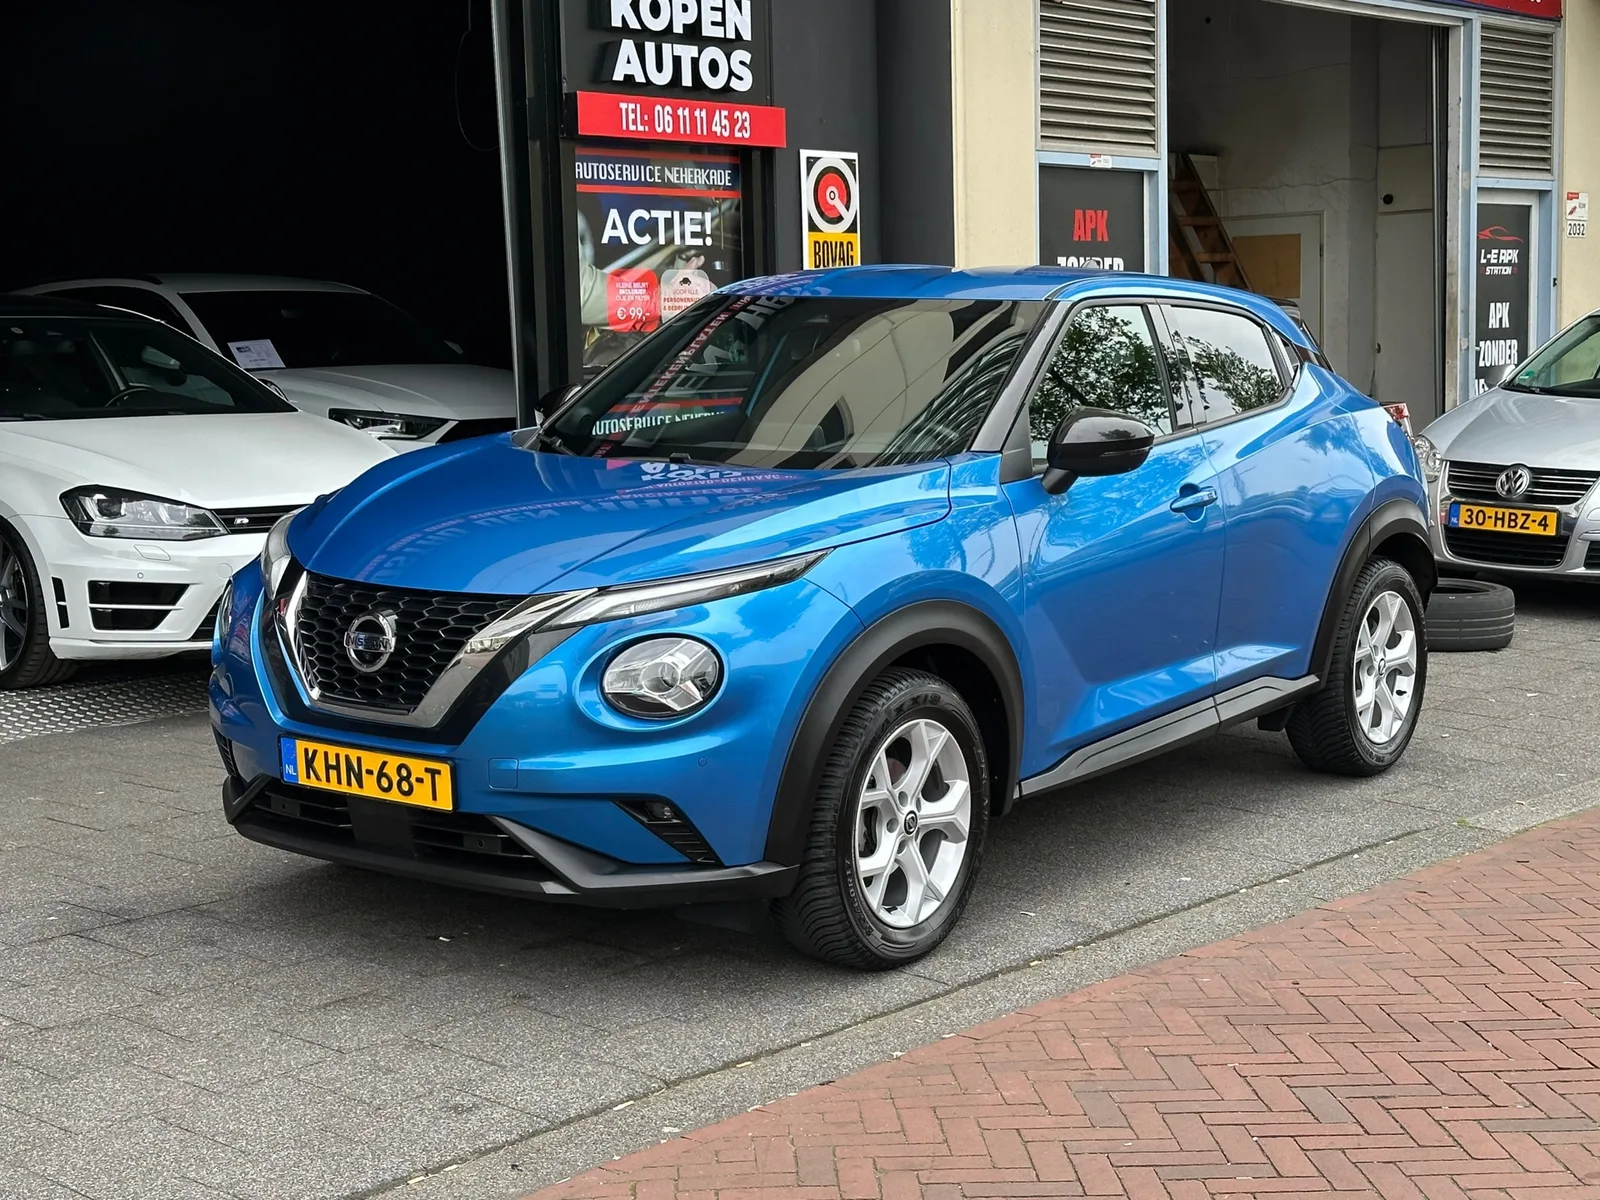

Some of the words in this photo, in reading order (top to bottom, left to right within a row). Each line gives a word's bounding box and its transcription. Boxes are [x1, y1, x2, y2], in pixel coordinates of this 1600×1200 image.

[611, 0, 752, 41] KOPEN
[612, 39, 753, 92] AUTOS
[619, 102, 649, 132] TEL:
[654, 104, 673, 134] 06
[677, 105, 690, 135] 11
[694, 107, 707, 136] 11
[712, 109, 730, 137] 45
[734, 110, 751, 139] 23
[575, 161, 662, 183] AUTOSERVICE
[664, 166, 732, 187] NEHERKADE
[601, 208, 712, 247] ACTIE!
[1072, 209, 1109, 242] APK
[1568, 222, 1586, 236] 2032
[813, 240, 854, 269] BOVAG
[1499, 249, 1519, 264] APK
[1485, 266, 1512, 275] STATION
[616, 307, 627, 320] €
[629, 307, 651, 321] 99,-
[1488, 302, 1510, 329] APK
[1479, 339, 1518, 367] ZONDER
[1464, 508, 1549, 532] 30-HBZ-4
[285, 764, 297, 776] NL
[303, 747, 442, 802] KHN-68-T
